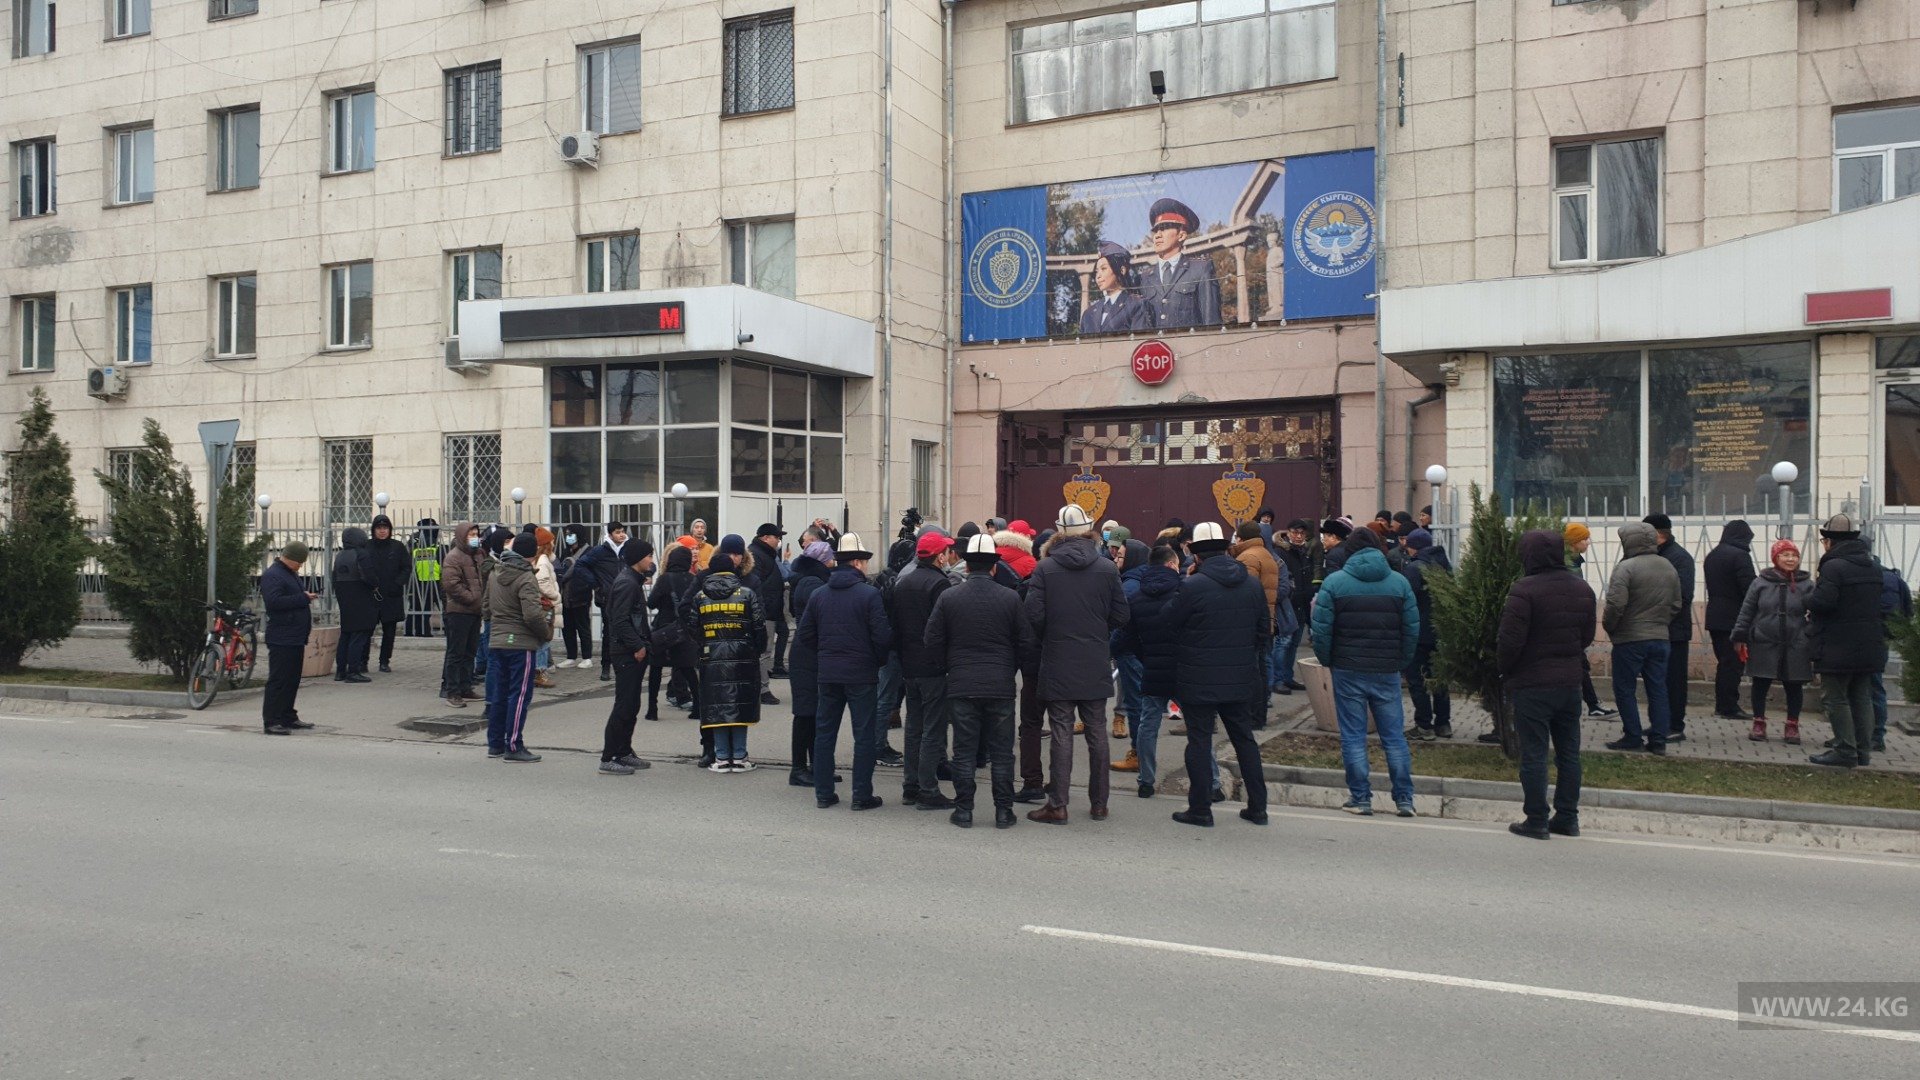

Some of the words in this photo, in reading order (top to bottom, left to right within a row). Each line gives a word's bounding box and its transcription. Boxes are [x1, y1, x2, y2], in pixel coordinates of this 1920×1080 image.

[1320, 193, 1354, 204] КЫРГЫЗ
[1306, 258, 1366, 276] РСПУБЛИКАСЫ
[1136, 354, 1170, 371] STOP
